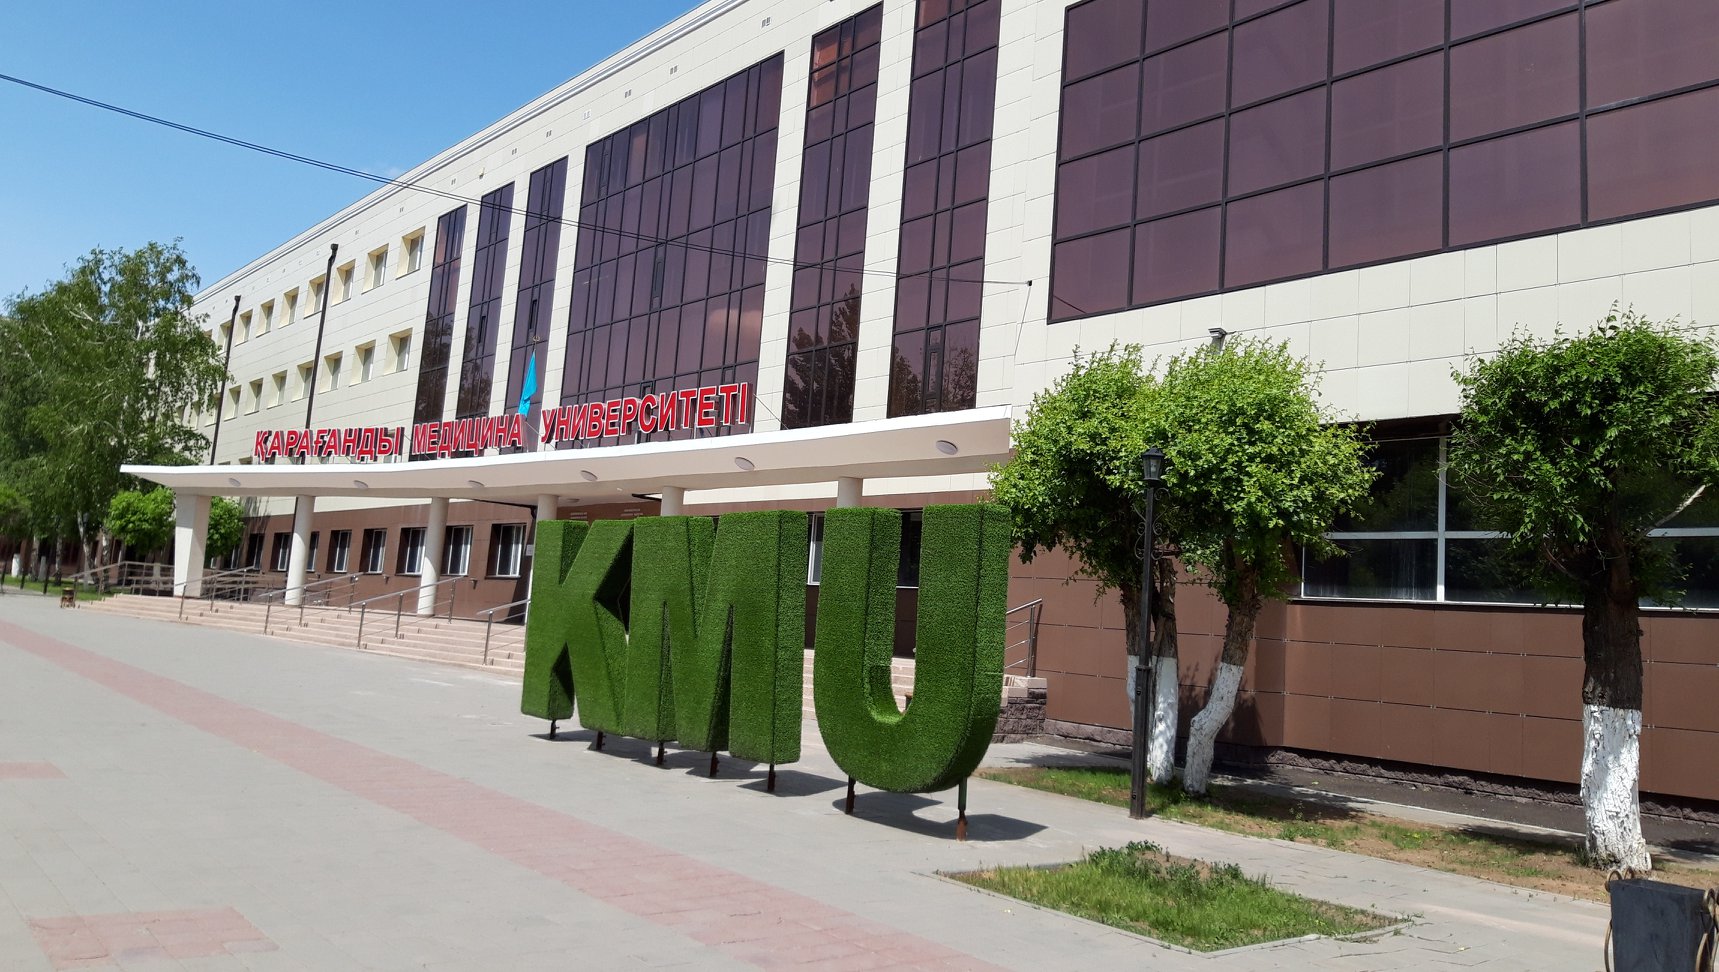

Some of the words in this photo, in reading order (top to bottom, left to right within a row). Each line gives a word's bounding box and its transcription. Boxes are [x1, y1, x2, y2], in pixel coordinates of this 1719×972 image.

[254, 426, 402, 462] ҚАРАҒАНДЫ
[412, 413, 523, 459] МЕДИЦИНА
[540, 382, 749, 443] УНИВЕРСИТЕТІ
[521, 504, 1011, 793] KMU
